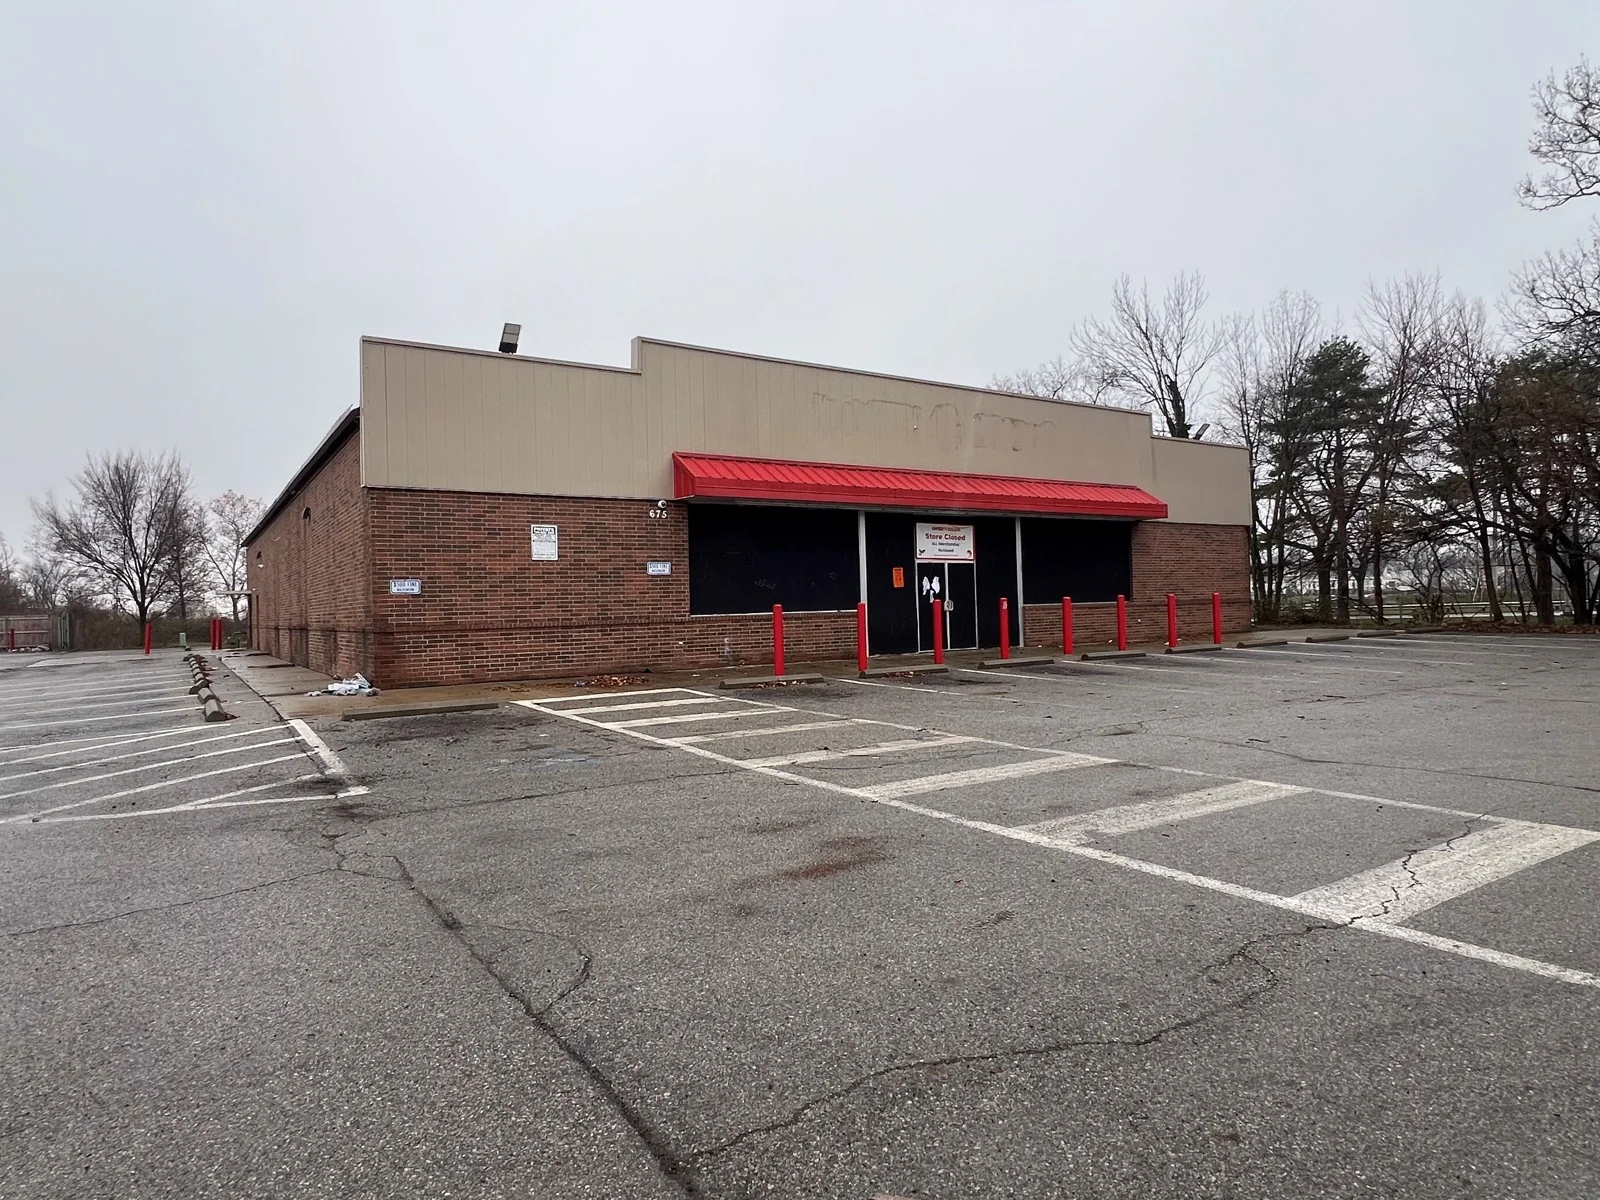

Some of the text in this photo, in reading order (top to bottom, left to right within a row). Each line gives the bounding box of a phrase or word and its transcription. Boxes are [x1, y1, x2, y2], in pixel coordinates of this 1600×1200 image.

[649, 509, 667, 518] 675
[925, 532, 966, 541] Store Closed
